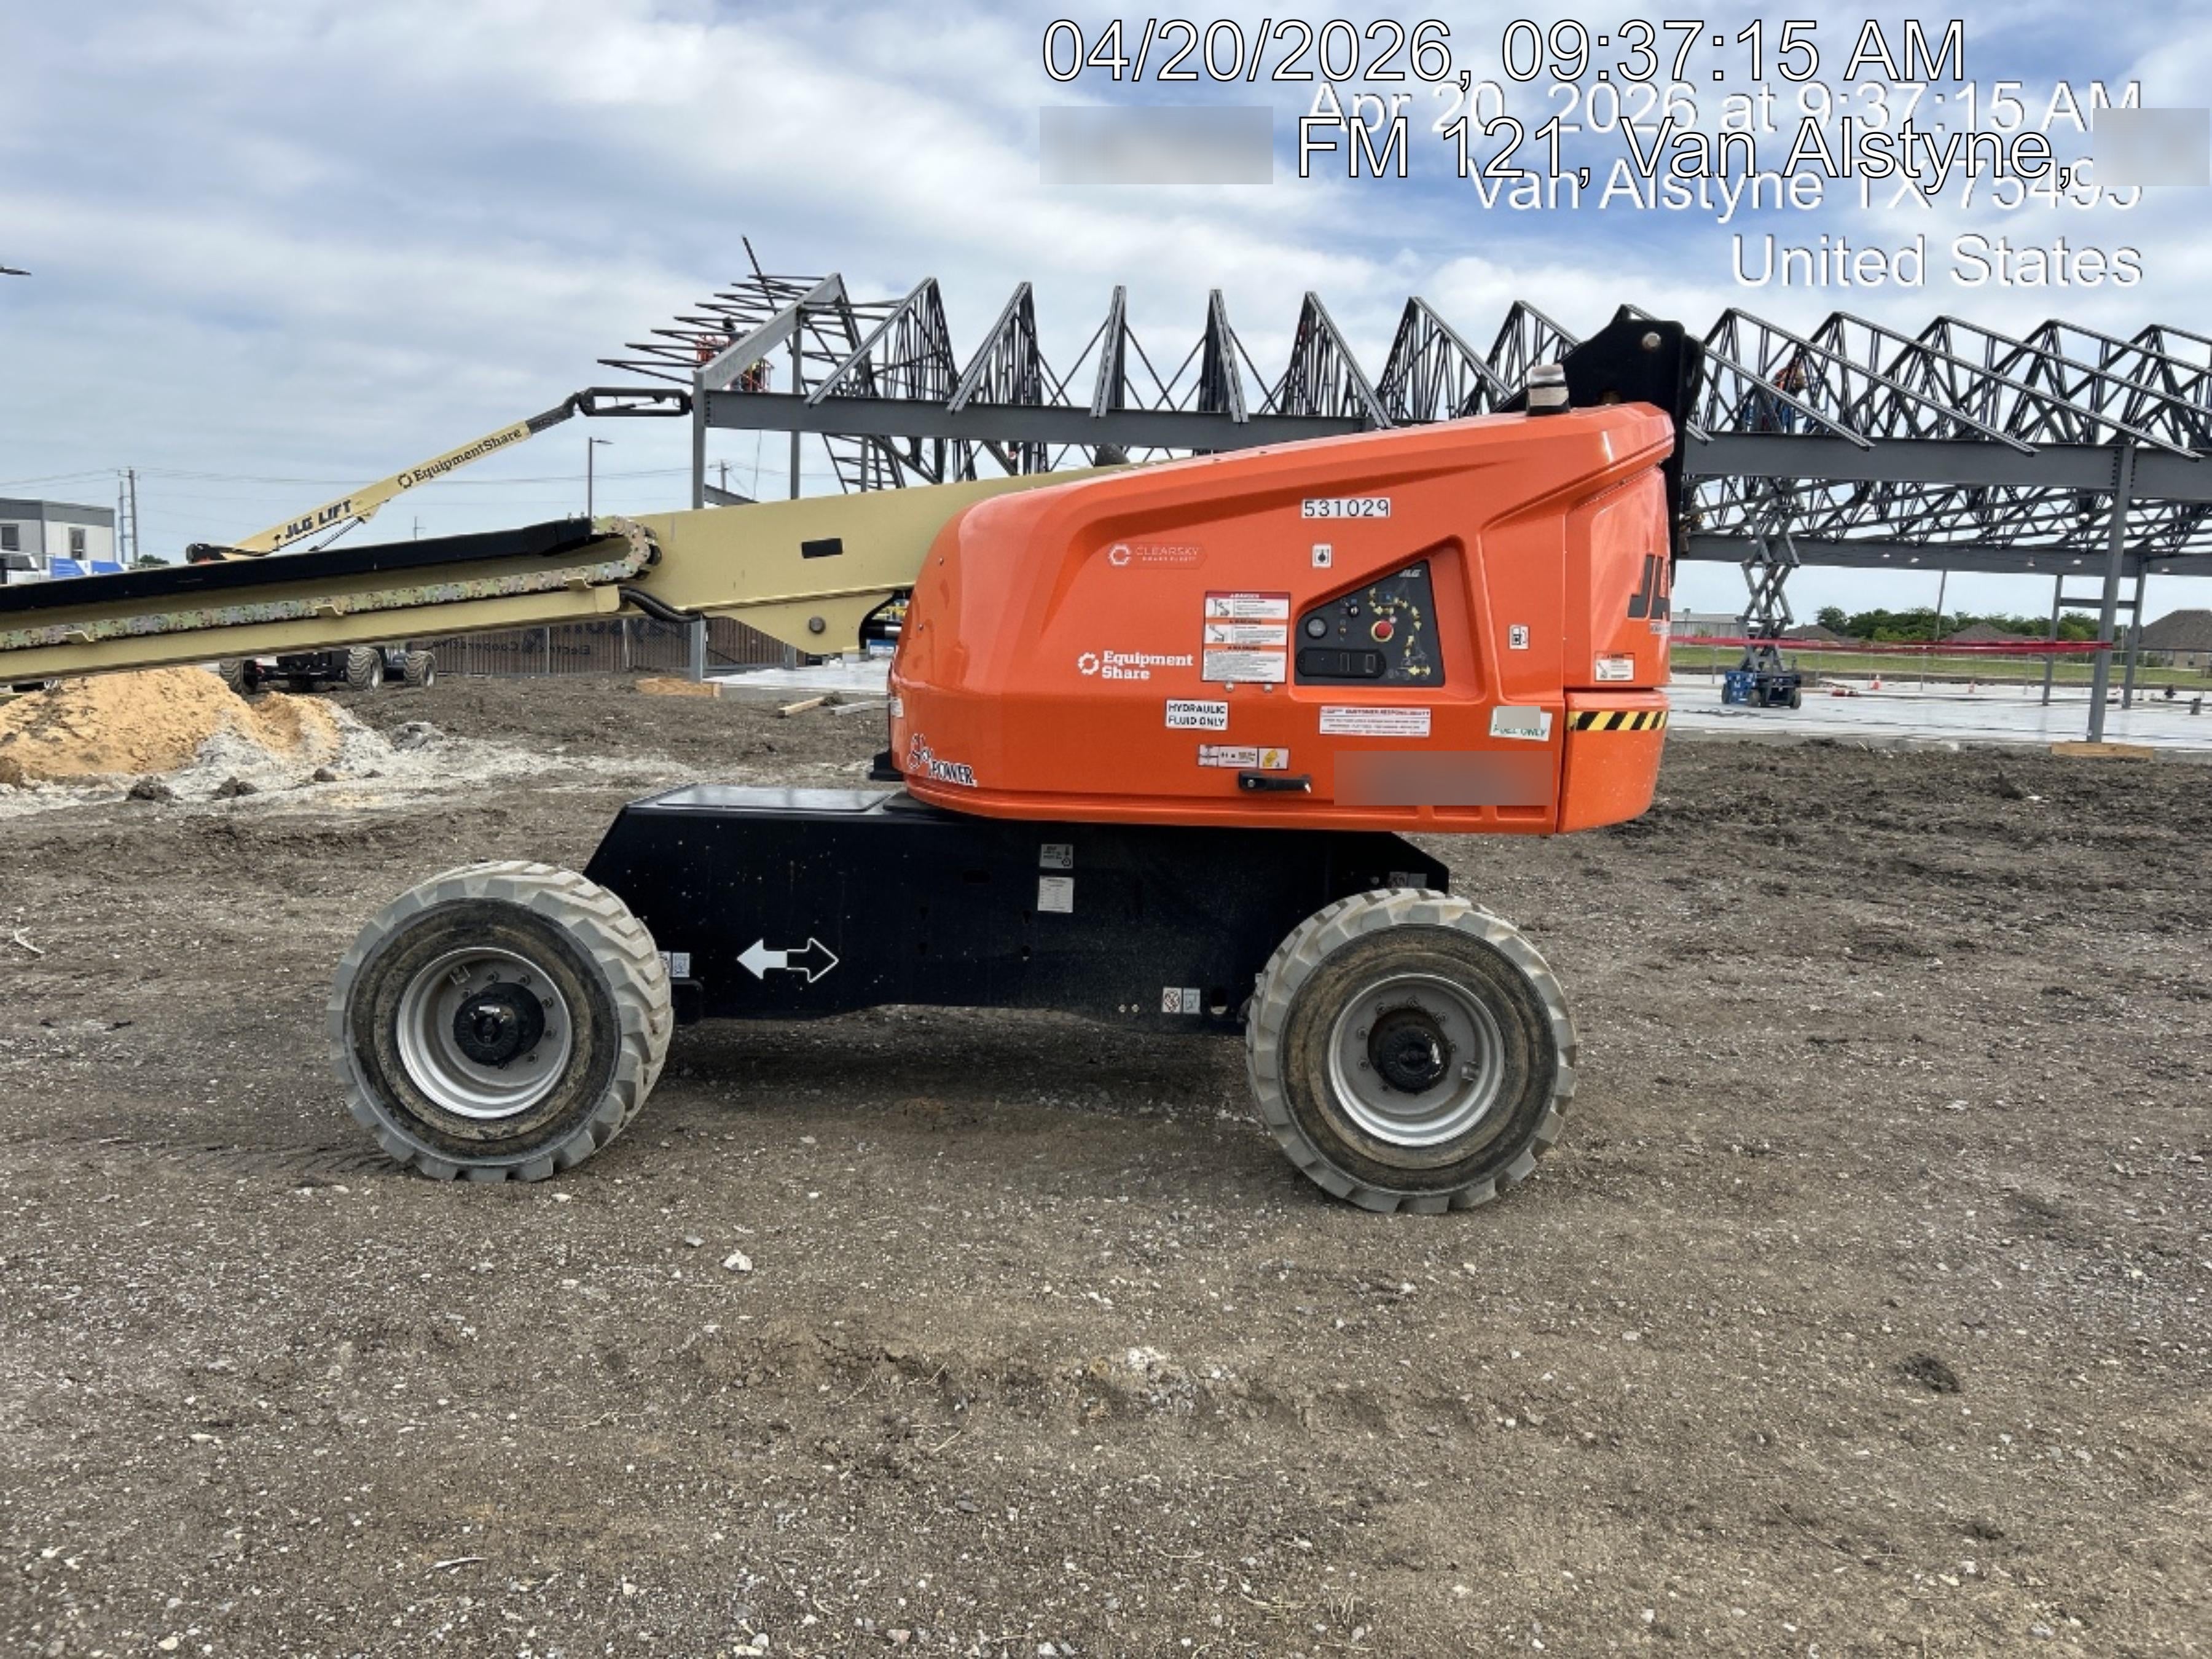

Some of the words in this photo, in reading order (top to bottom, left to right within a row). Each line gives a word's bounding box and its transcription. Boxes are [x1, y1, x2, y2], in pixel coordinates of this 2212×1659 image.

[412, 428, 522, 483] EquipmentShare
[1304, 499, 1389, 517] 531029
[285, 516, 313, 539] JLG
[318, 499, 351, 525] LIFT
[1135, 546, 1198, 556] CLEARSKY
[1627, 554, 1671, 621] JL
[1102, 649, 1193, 667] Equipment
[1102, 665, 1151, 680] Share
[1167, 704, 1226, 715] HYDRAULIC
[1168, 716, 1196, 726] FLUID
[1199, 716, 1225, 727] ONLY
